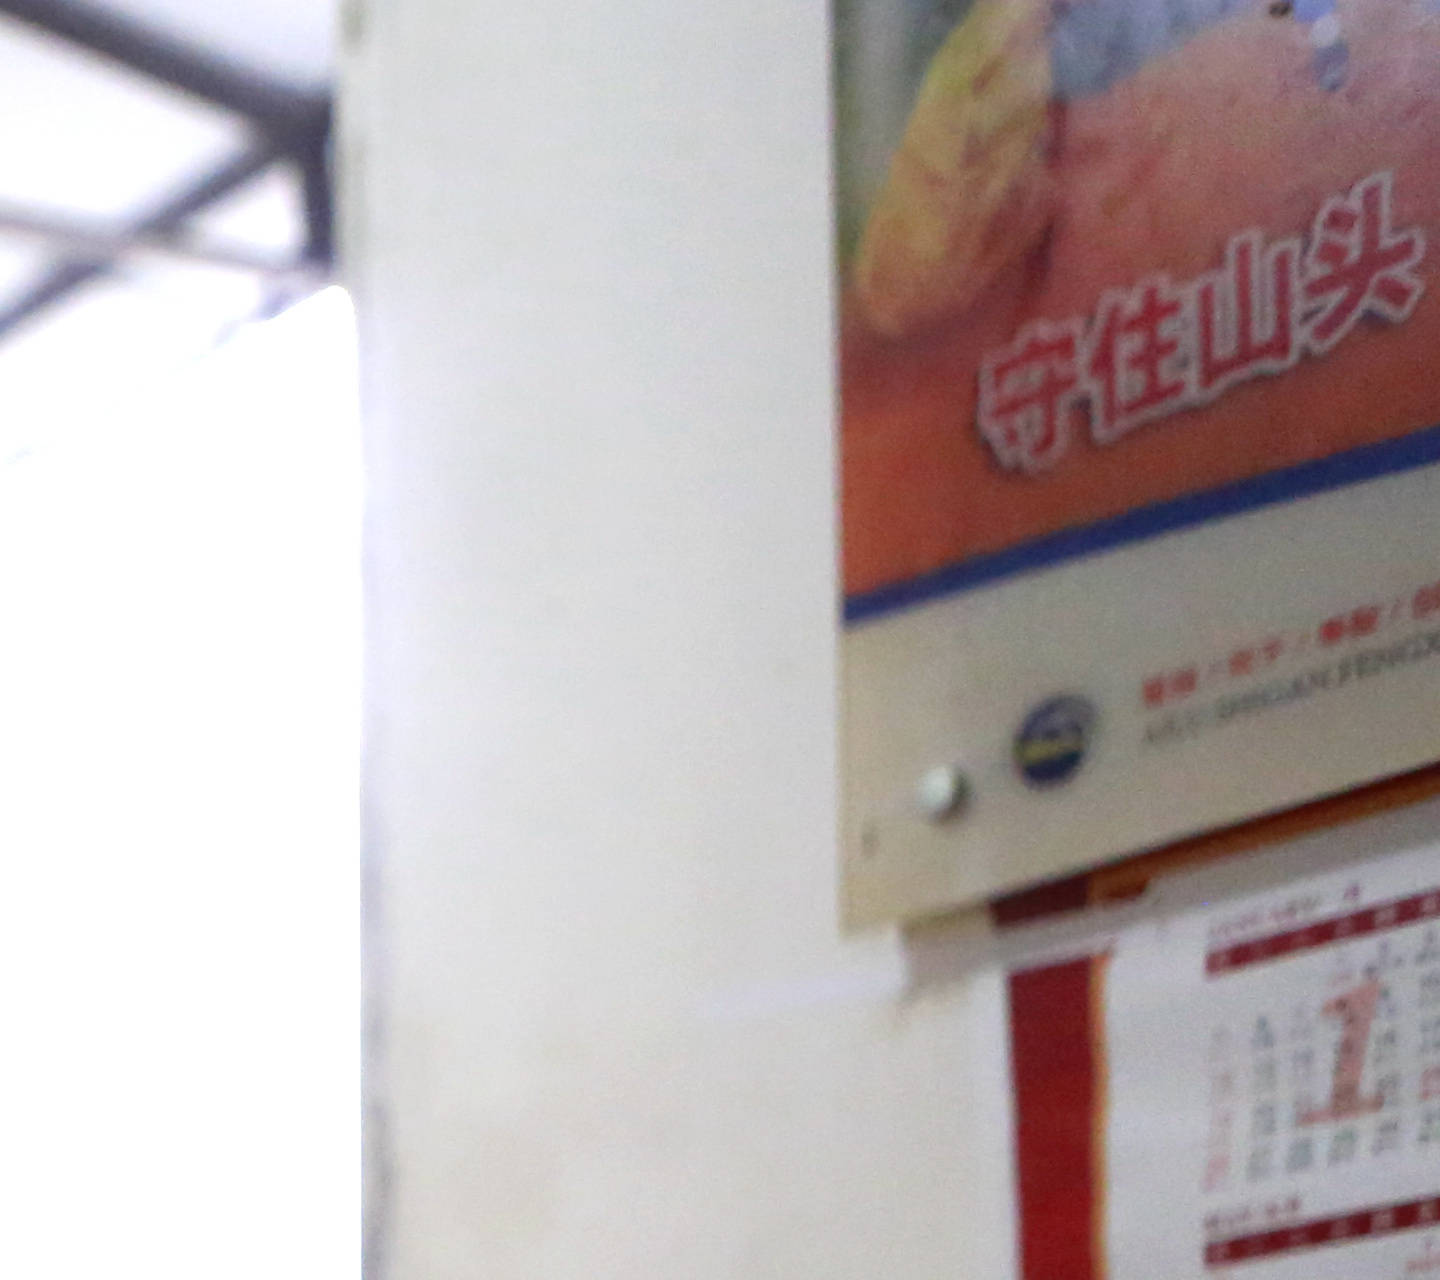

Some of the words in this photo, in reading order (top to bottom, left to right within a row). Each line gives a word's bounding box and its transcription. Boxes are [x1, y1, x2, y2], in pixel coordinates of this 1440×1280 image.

[980, 172, 1423, 470] 守住山头
[1295, 979, 1382, 1126] 1
